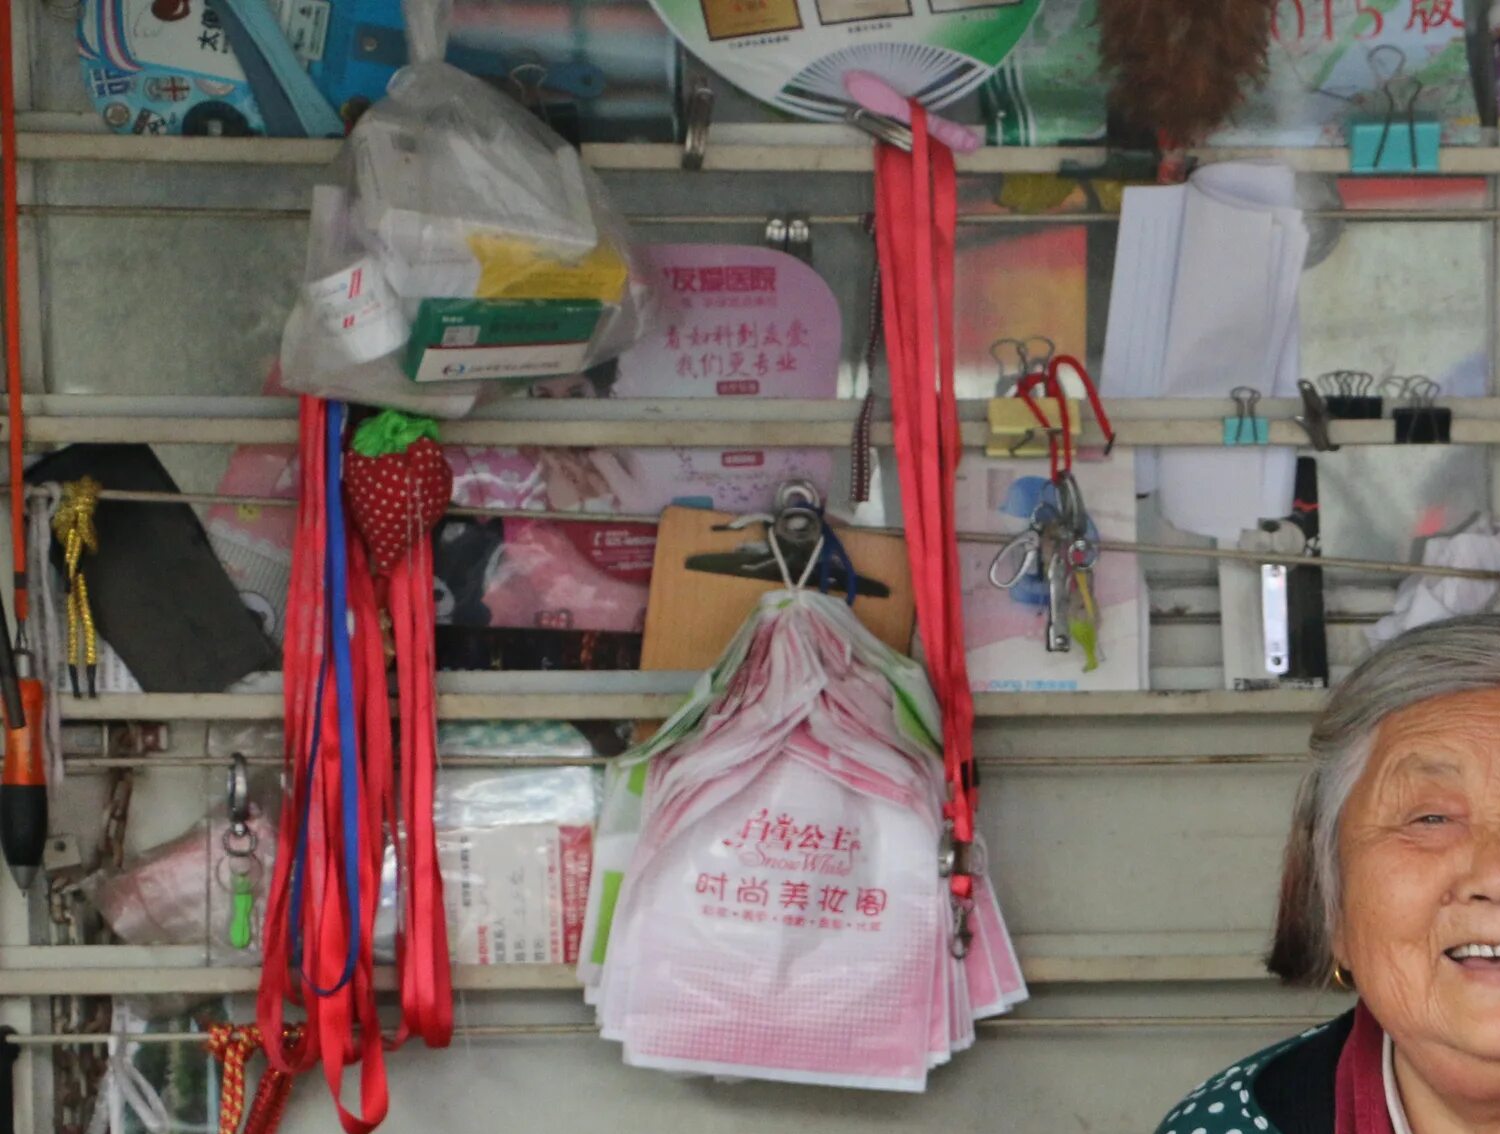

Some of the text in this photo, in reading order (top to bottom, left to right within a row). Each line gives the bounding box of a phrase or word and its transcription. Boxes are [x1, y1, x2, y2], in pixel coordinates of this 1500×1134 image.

[695, 872, 888, 918] 时尚美妆阁
